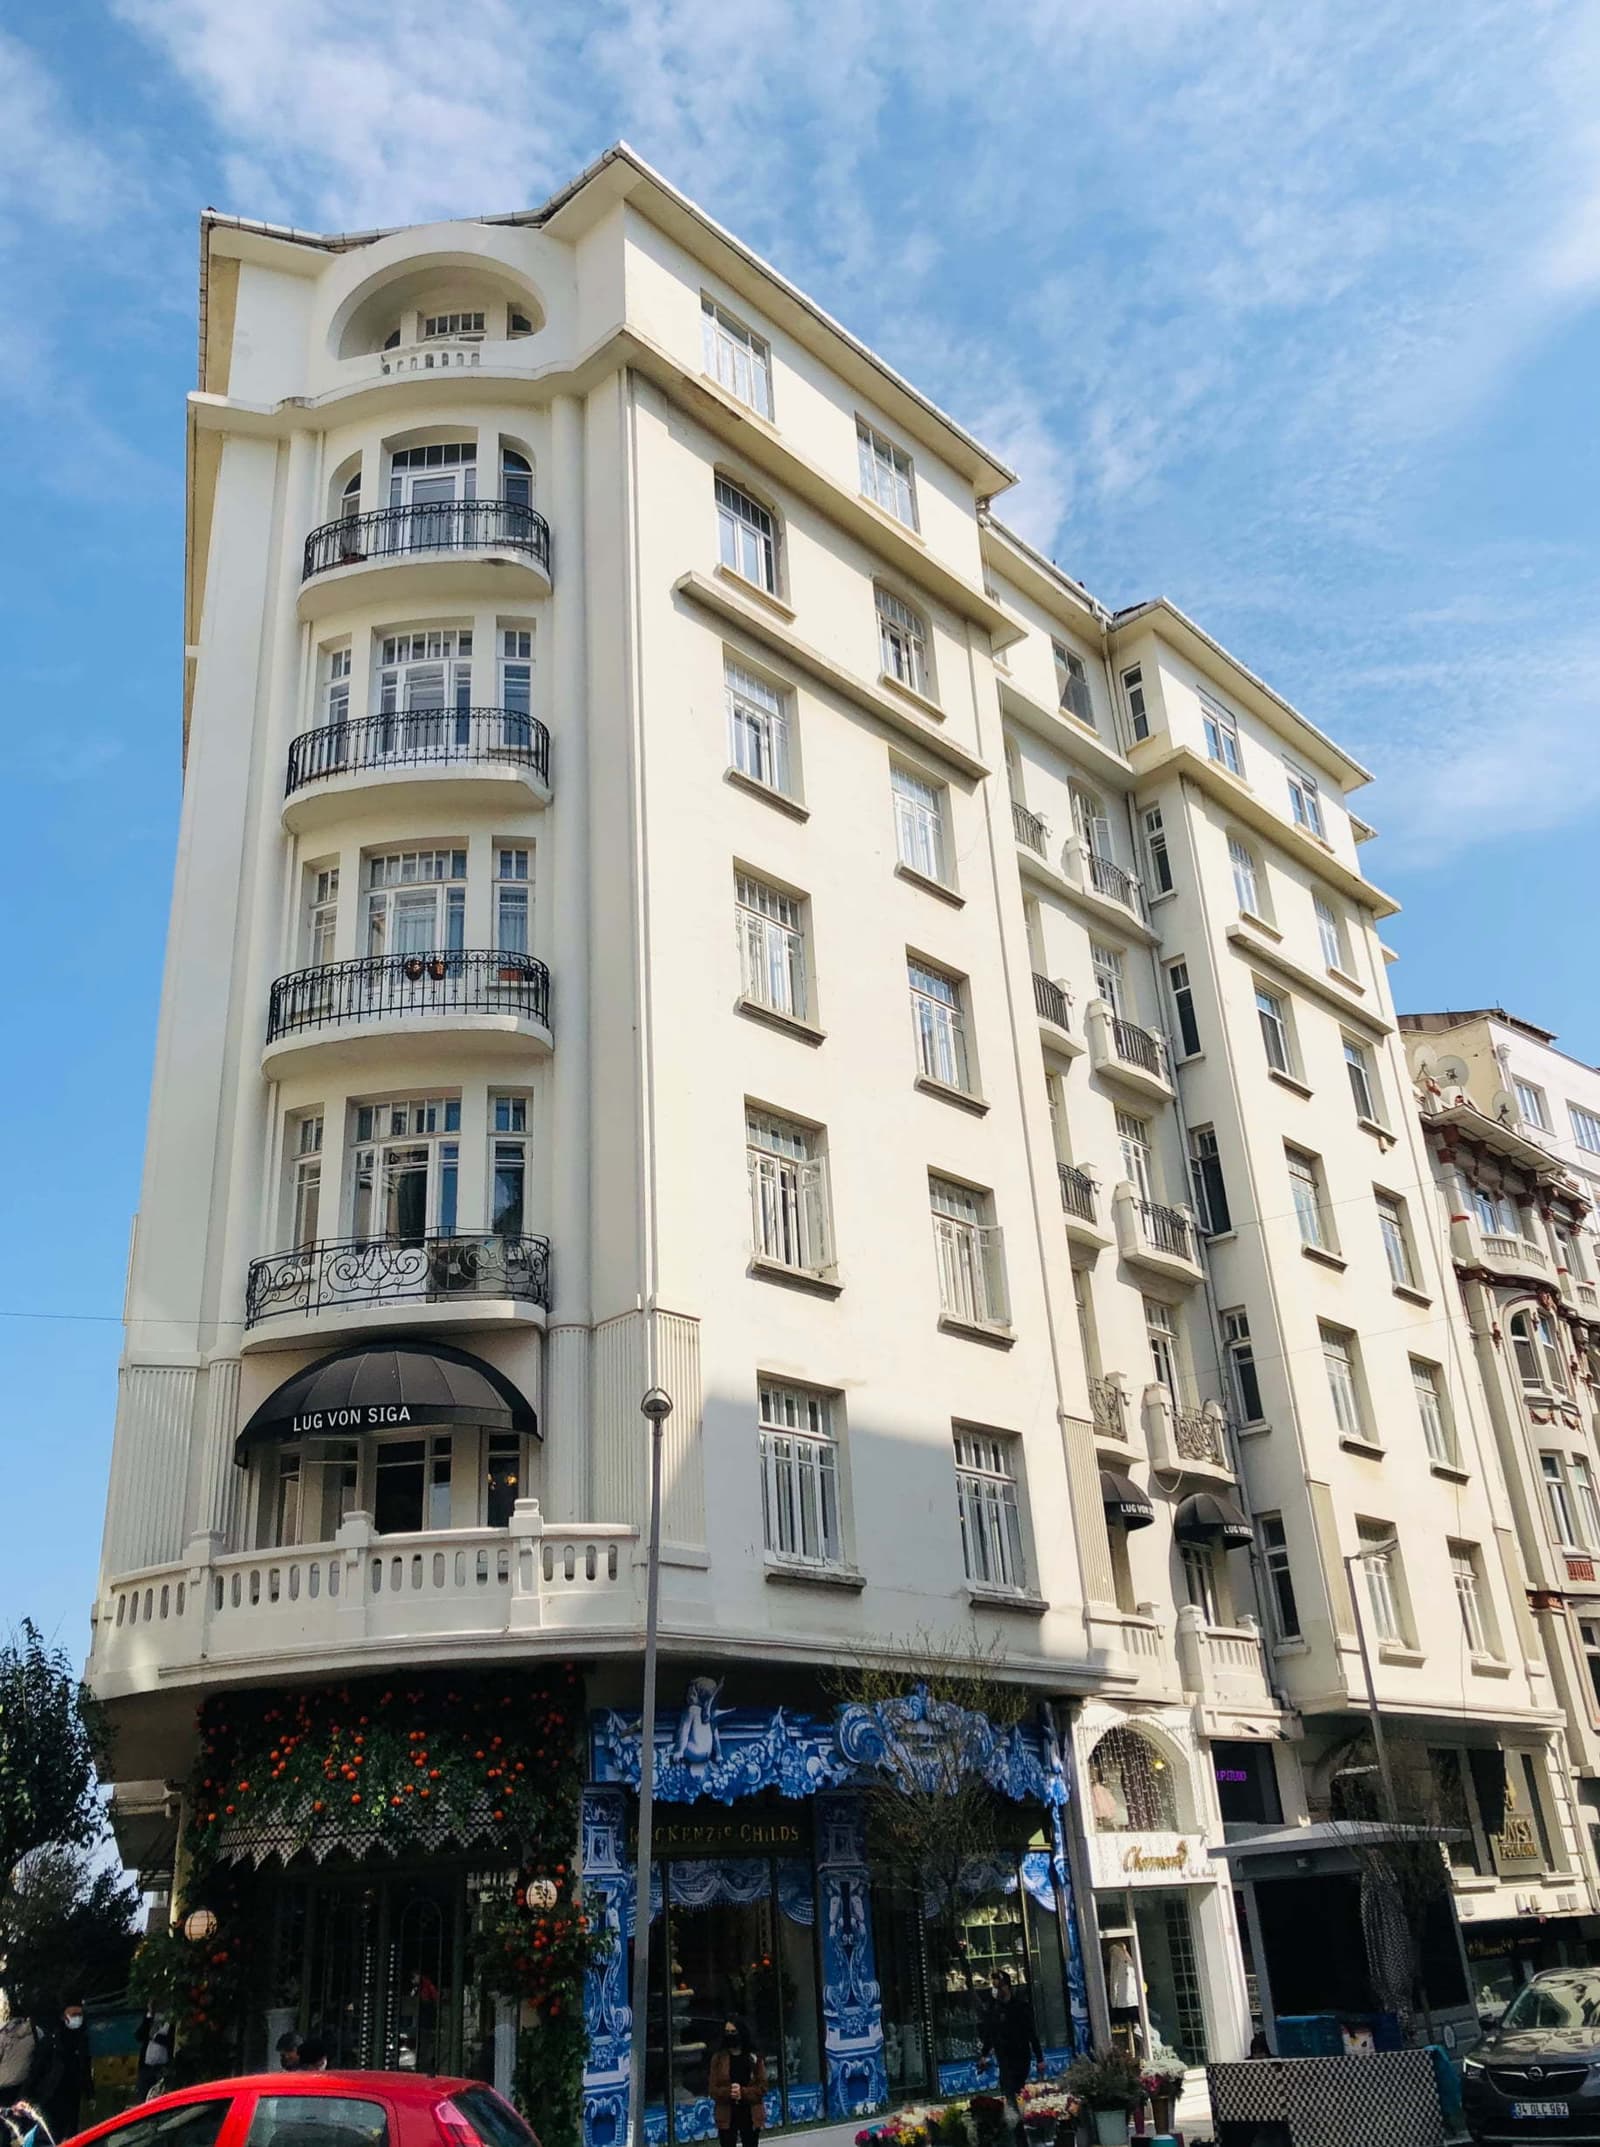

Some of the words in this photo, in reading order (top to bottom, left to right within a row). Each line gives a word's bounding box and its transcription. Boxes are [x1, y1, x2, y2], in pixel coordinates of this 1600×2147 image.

[293, 1413, 322, 1432] LUG
[327, 1408, 361, 1427] VON
[368, 1406, 411, 1424] SIGA
[1120, 1503, 1137, 1513] LUG
[1223, 1525, 1238, 1535] LUG
